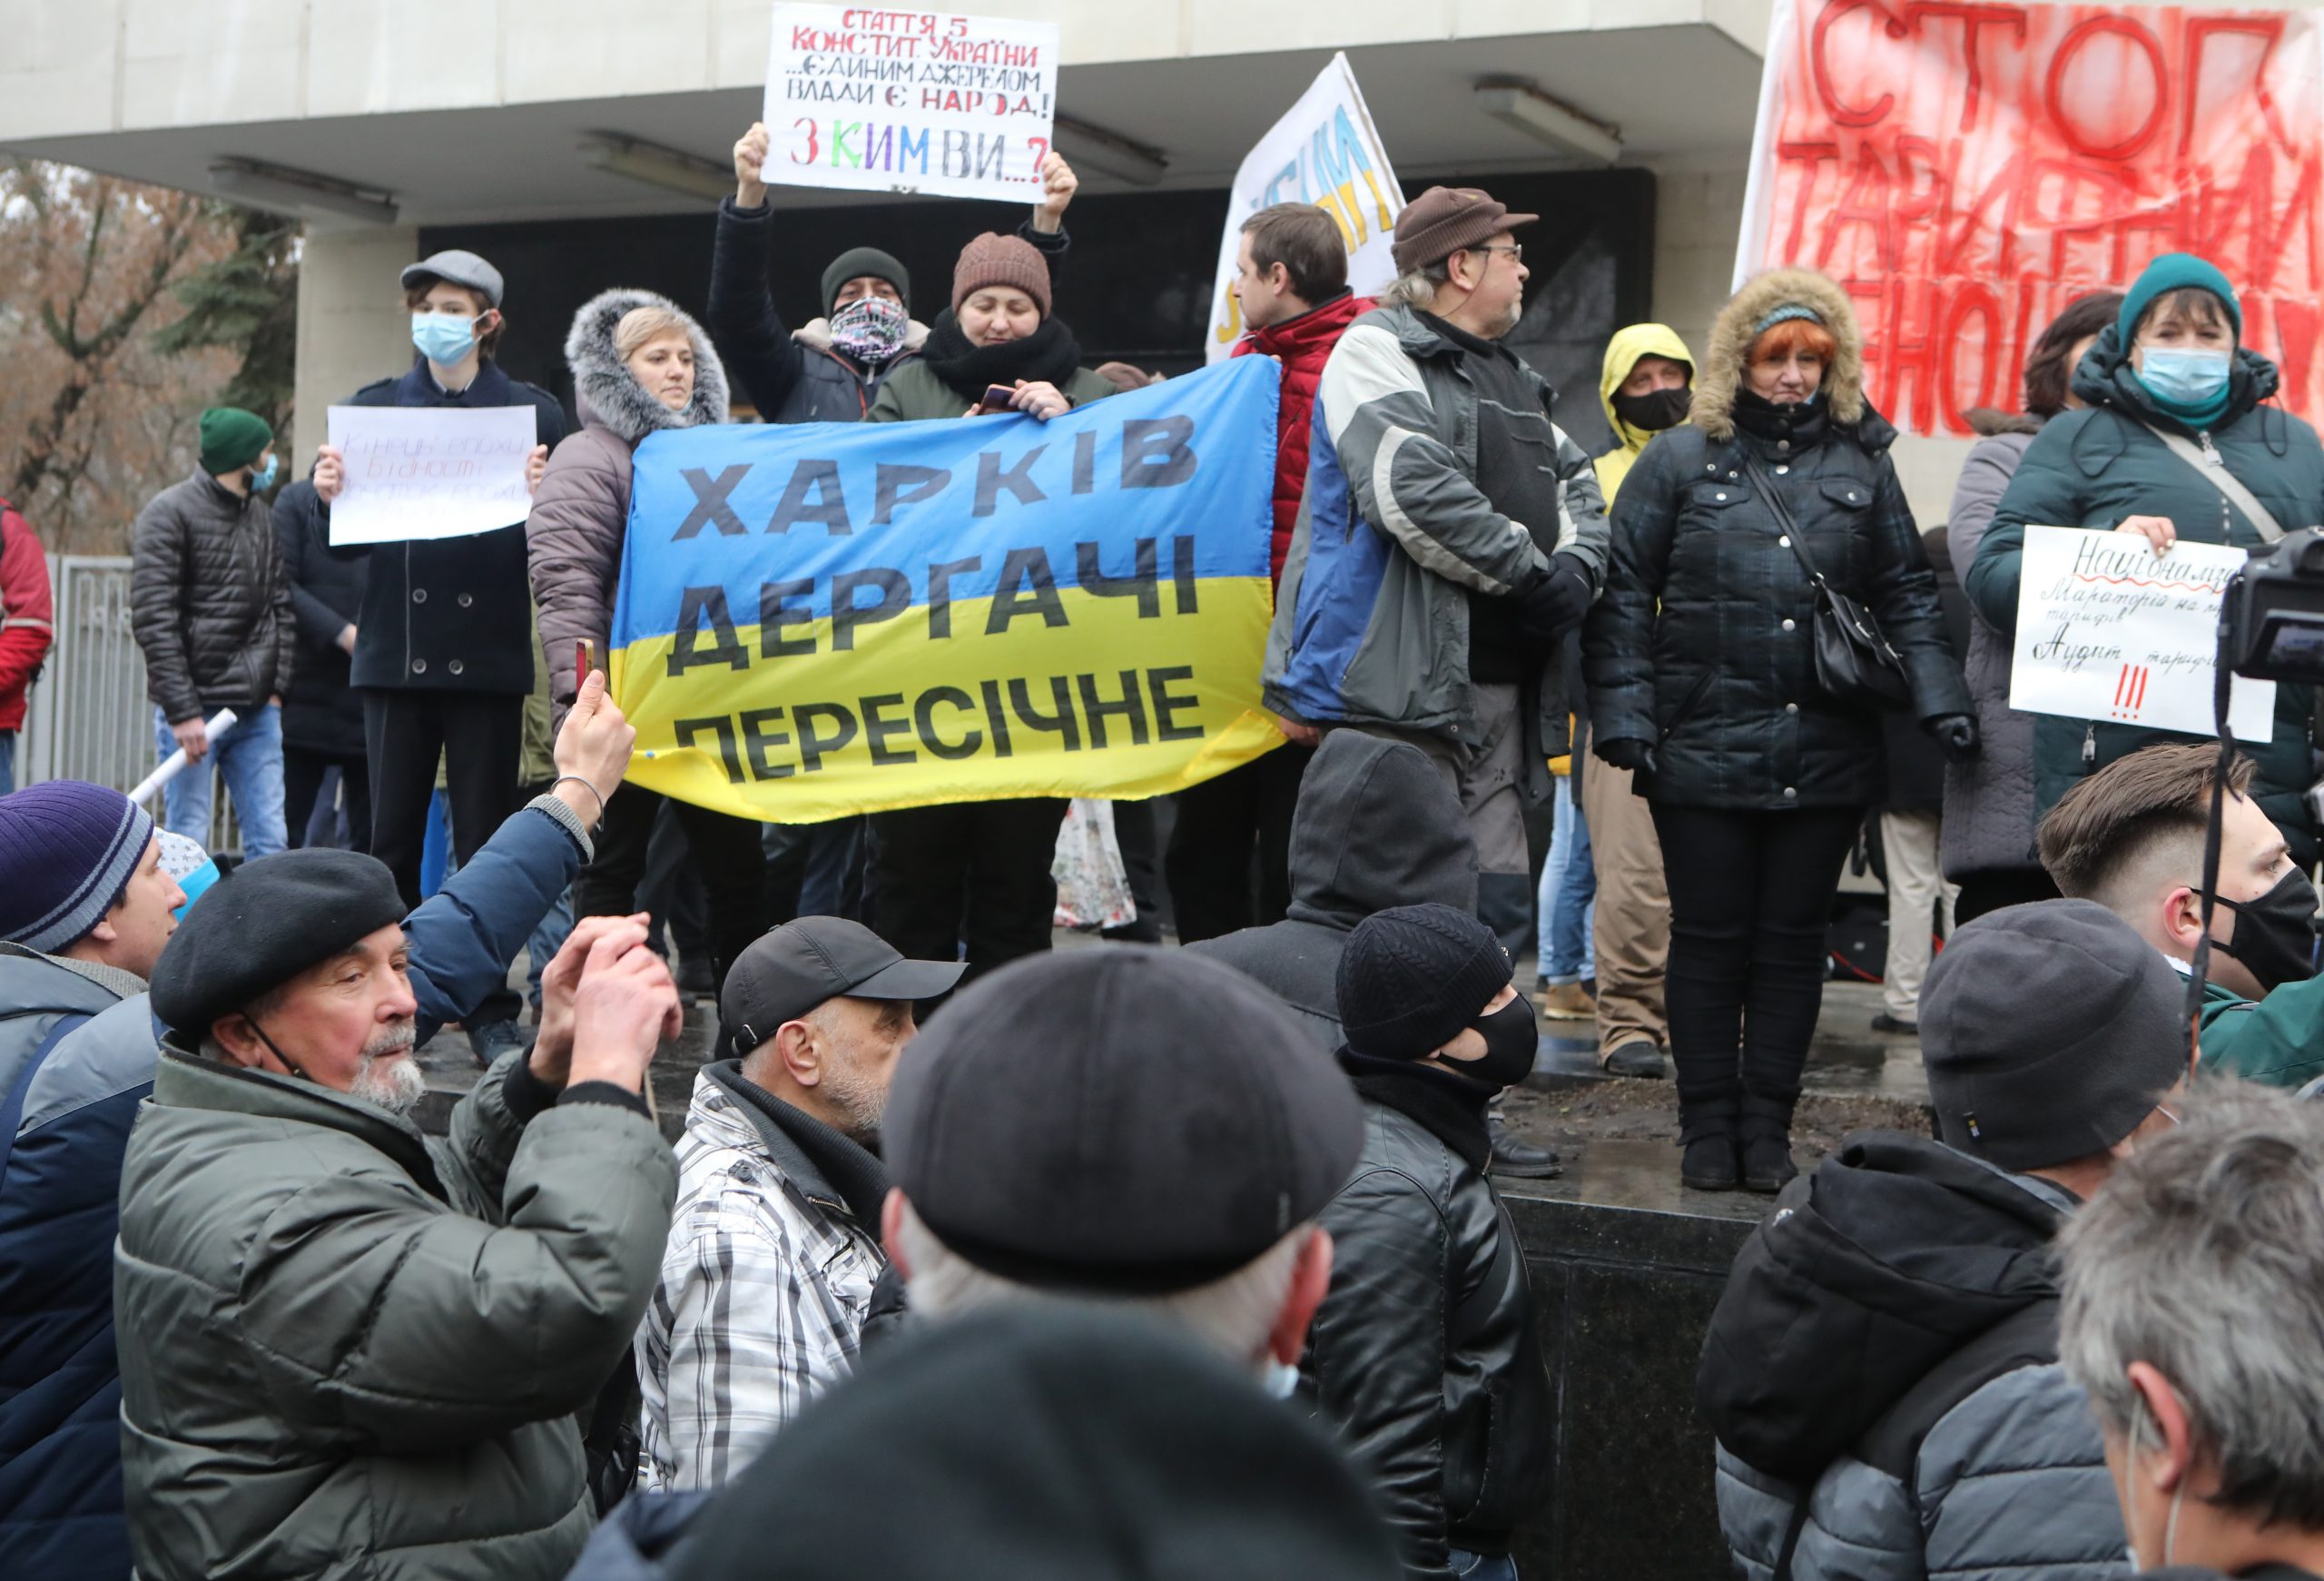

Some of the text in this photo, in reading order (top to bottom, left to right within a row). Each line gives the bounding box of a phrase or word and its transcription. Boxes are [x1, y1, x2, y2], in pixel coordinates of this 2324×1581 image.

[842, 9, 969, 36] СТАТТЯ 5
[930, 35, 1039, 67] УКРАЇНИ
[787, 79, 1050, 119] ВЛАДИ Є НАРОД!
[919, 64, 1040, 93] ДЖЕРЕЛОМ
[1812, 0, 2296, 160] СТОП
[831, 120, 930, 175] КИМ
[671, 414, 1198, 542] ХАРКІВ
[666, 535, 1199, 677] ДЕРГАЧІ
[2034, 622, 2121, 673] Аудит
[674, 665, 1205, 785] ПЕРЕСІЧНЕ
